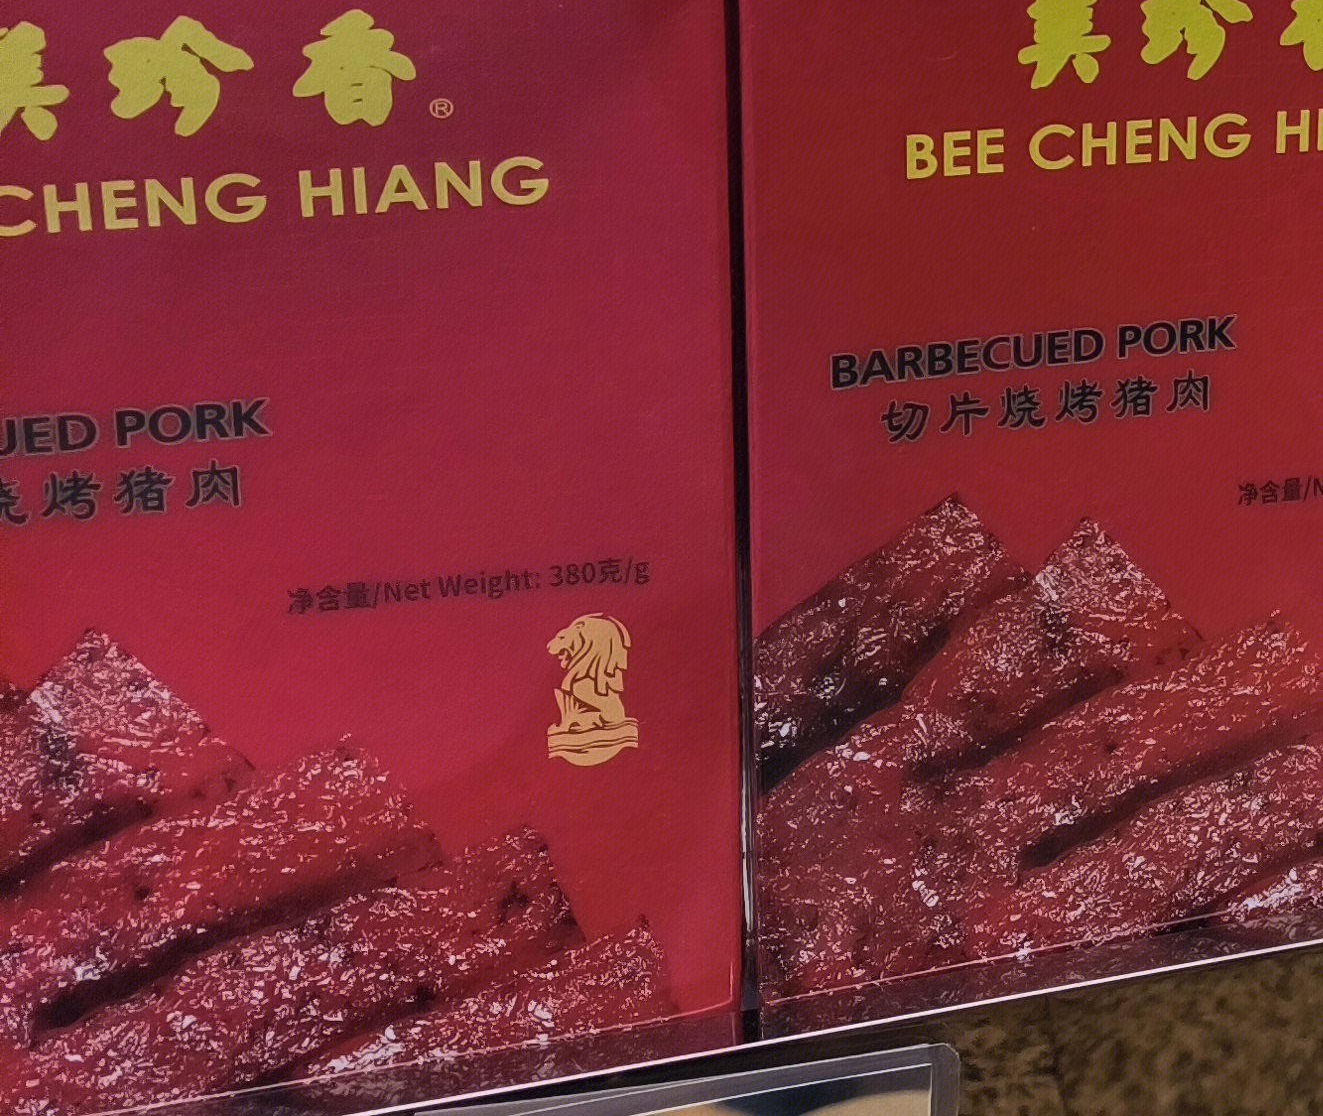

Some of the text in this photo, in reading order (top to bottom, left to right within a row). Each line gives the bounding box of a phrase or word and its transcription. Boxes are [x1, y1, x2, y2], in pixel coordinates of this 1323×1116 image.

[906, 128, 1004, 178] BEE
[1029, 113, 1251, 169] CHENG
[0, 157, 549, 236] CHENG HIANG
[830, 314, 1237, 390] BARBECUED PORK
[114, 398, 270, 448] PORK
[882, 370, 1211, 442] 切片烧烤猪肉
[438, 568, 541, 600] Weight:
[550, 556, 650, 586] 380克/g
